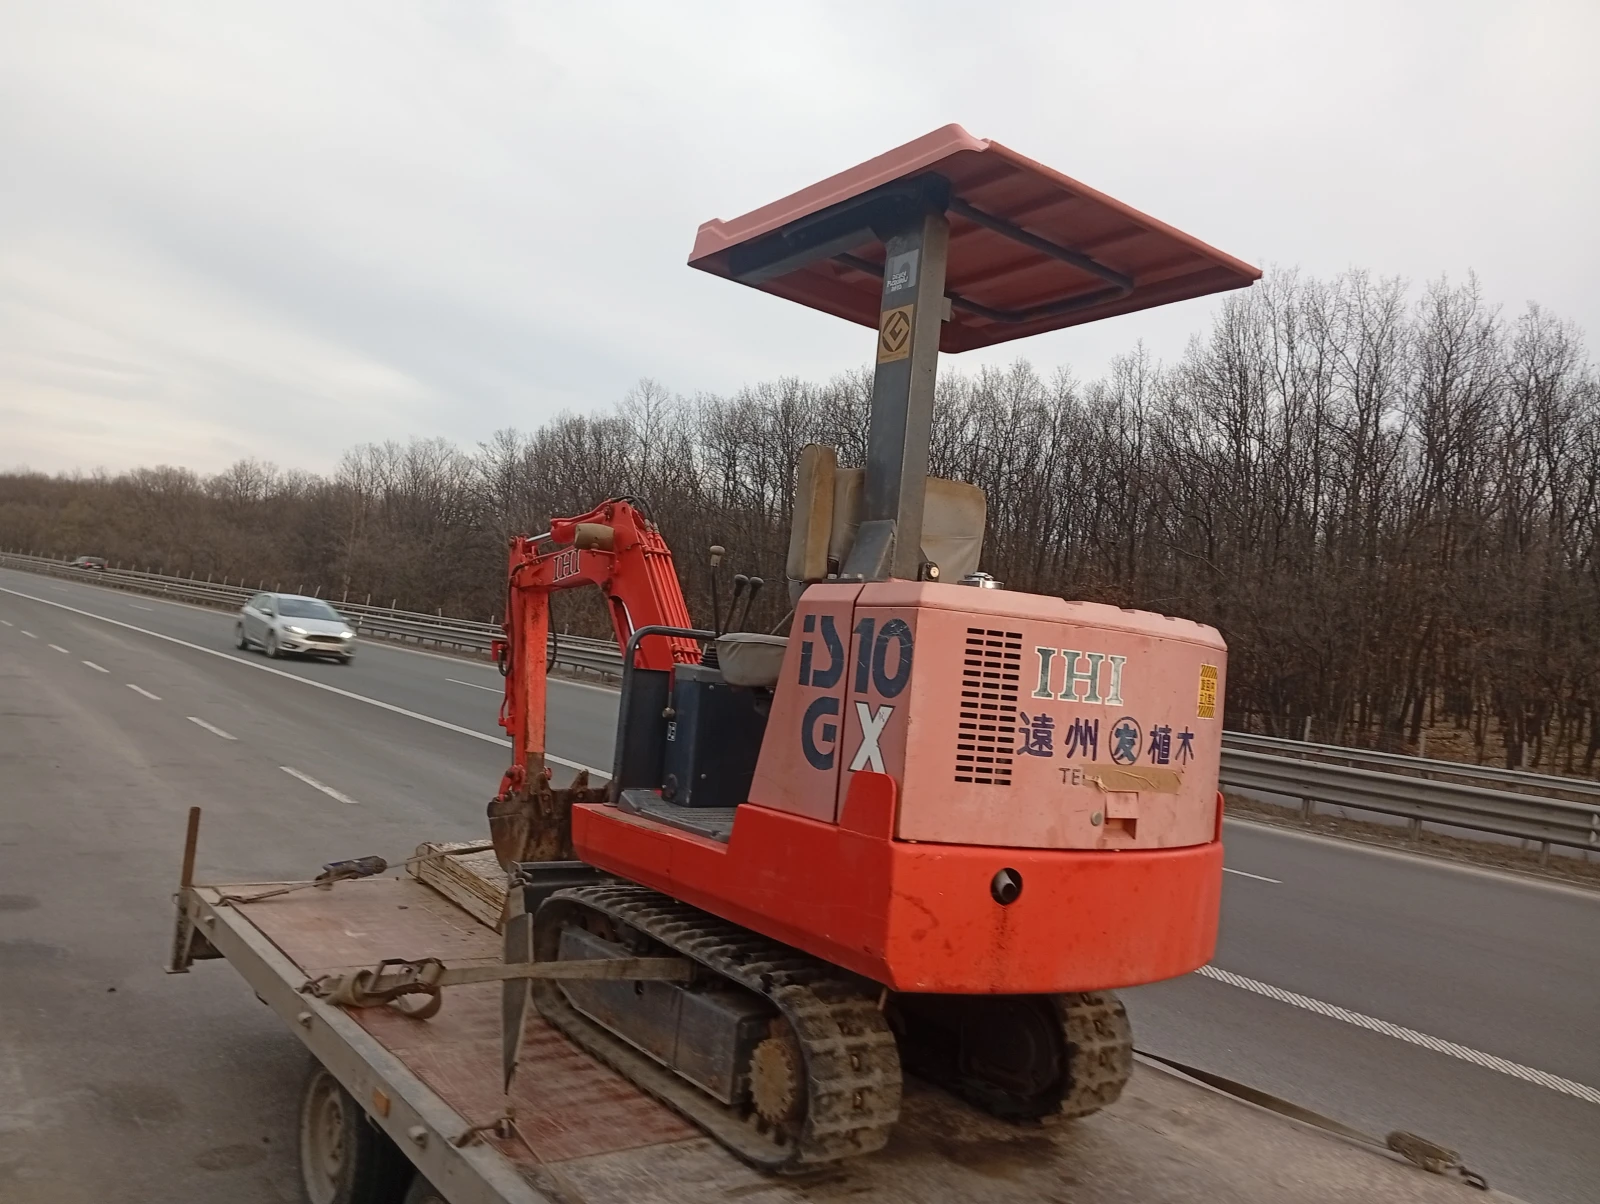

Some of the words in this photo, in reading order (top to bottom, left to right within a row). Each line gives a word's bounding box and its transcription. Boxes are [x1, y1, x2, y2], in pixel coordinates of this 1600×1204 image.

[552, 548, 581, 583] IHI
[1031, 645, 1127, 706] IHI
[801, 696, 896, 775] GX
[1058, 767, 1086, 786] TE
